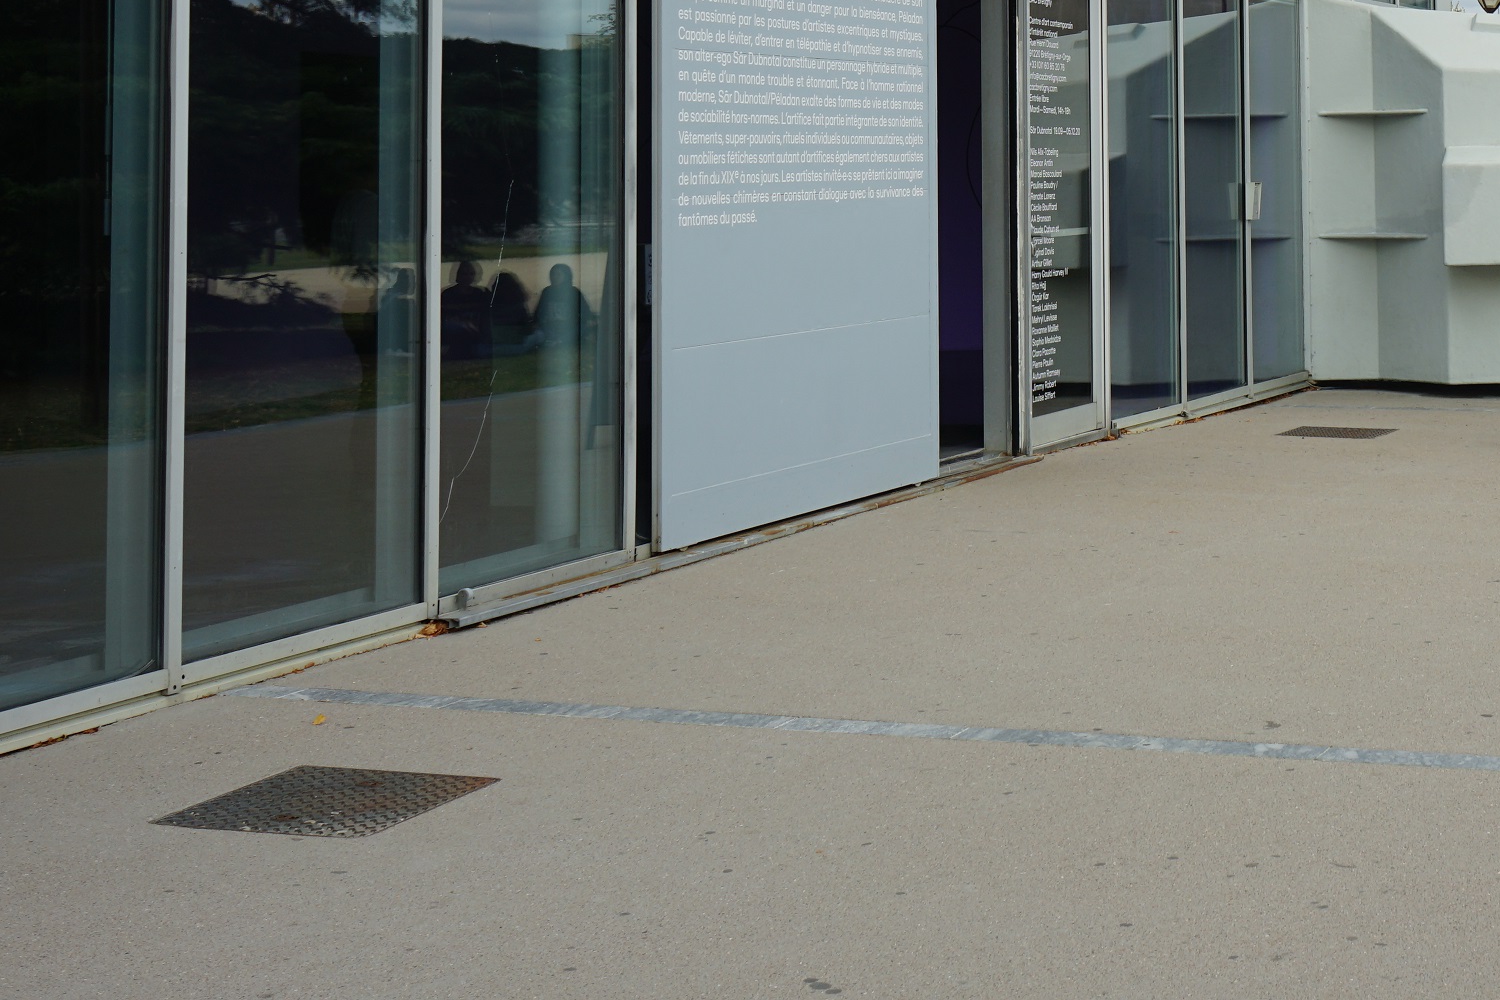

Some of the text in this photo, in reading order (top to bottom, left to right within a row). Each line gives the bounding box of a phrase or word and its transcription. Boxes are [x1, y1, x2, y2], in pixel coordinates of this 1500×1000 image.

[786, 0, 794, 10] et
[796, 2, 805, 12] un
[807, 0, 831, 17] danger
[834, 6, 849, 18] pour
[851, 5, 857, 17] la
[898, 11, 923, 24] Péladan
[678, 8, 692, 20] est
[694, 10, 736, 24] passionné
[738, 15, 751, 28] par
[753, 14, 765, 27] les
[767, 17, 800, 31] postures
[881, 28, 887, 38] et
[678, 26, 713, 44] Capable
[715, 30, 725, 43] de
[785, 39, 794, 48] en
[833, 41, 840, 52] et
[883, 47, 895, 56] ses
[678, 71, 689, 81] en
[692, 69, 715, 85] quête
[738, 72, 765, 85] monde
[767, 74, 793, 86] trouble
[796, 76, 804, 87] et
[841, 77, 858, 89] Face
[860, 78, 864, 90] à
[896, 81, 923, 93] rationnel
[801, 94, 822, 106] exalte
[823, 95, 836, 107] des
[838, 96, 861, 108] formes
[862, 97, 871, 108] de
[872, 97, 881, 108] vie
[882, 99, 889, 109] et
[890, 98, 901, 109] des
[902, 99, 923, 110] modes
[678, 109, 689, 122] de
[812, 113, 824, 125] fait
[824, 114, 844, 128] partie
[879, 115, 887, 126] de
[887, 118, 899, 127] son
[782, 132, 804, 144] rituels
[841, 135, 849, 144] ou
[904, 133, 923, 147] objets
[678, 193, 689, 205] de
[691, 191, 730, 205] nouvelles
[733, 190, 769, 203] chimères
[771, 193, 781, 202] en
[783, 190, 816, 201] constant
[818, 188, 847, 203] dialogue
[849, 190, 866, 199] avec
[867, 187, 874, 198] la
[911, 185, 923, 196] des
[678, 212, 718, 226] fantômes
[719, 211, 730, 224] du
